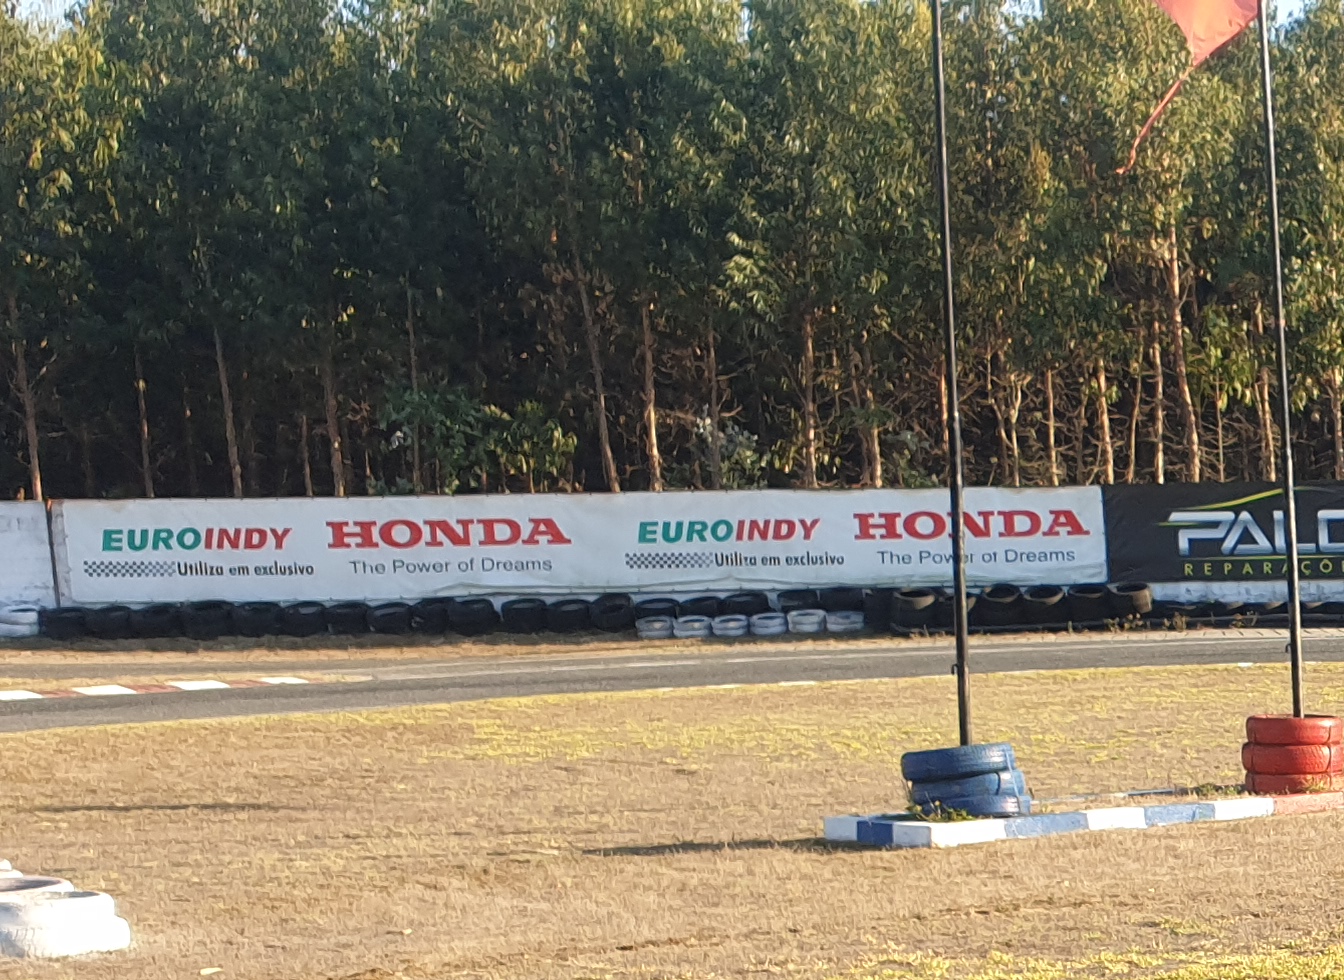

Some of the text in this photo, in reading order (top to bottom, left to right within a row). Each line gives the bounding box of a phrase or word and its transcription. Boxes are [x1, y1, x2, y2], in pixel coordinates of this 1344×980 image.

[326, 518, 572, 549] HONDA
[637, 518, 821, 545] EUROINDY
[853, 509, 1091, 541] HONDA
[102, 527, 293, 552] EUROINDY
[177, 559, 315, 577] Utiliza em exclusivo
[349, 555, 553, 576] The Power of Dreams
[761, 556, 781, 567] em
[785, 551, 845, 566] exclusivo
[877, 551, 912, 565] The
[981, 550, 998, 564] of
[1004, 549, 1076, 564] Dreams
